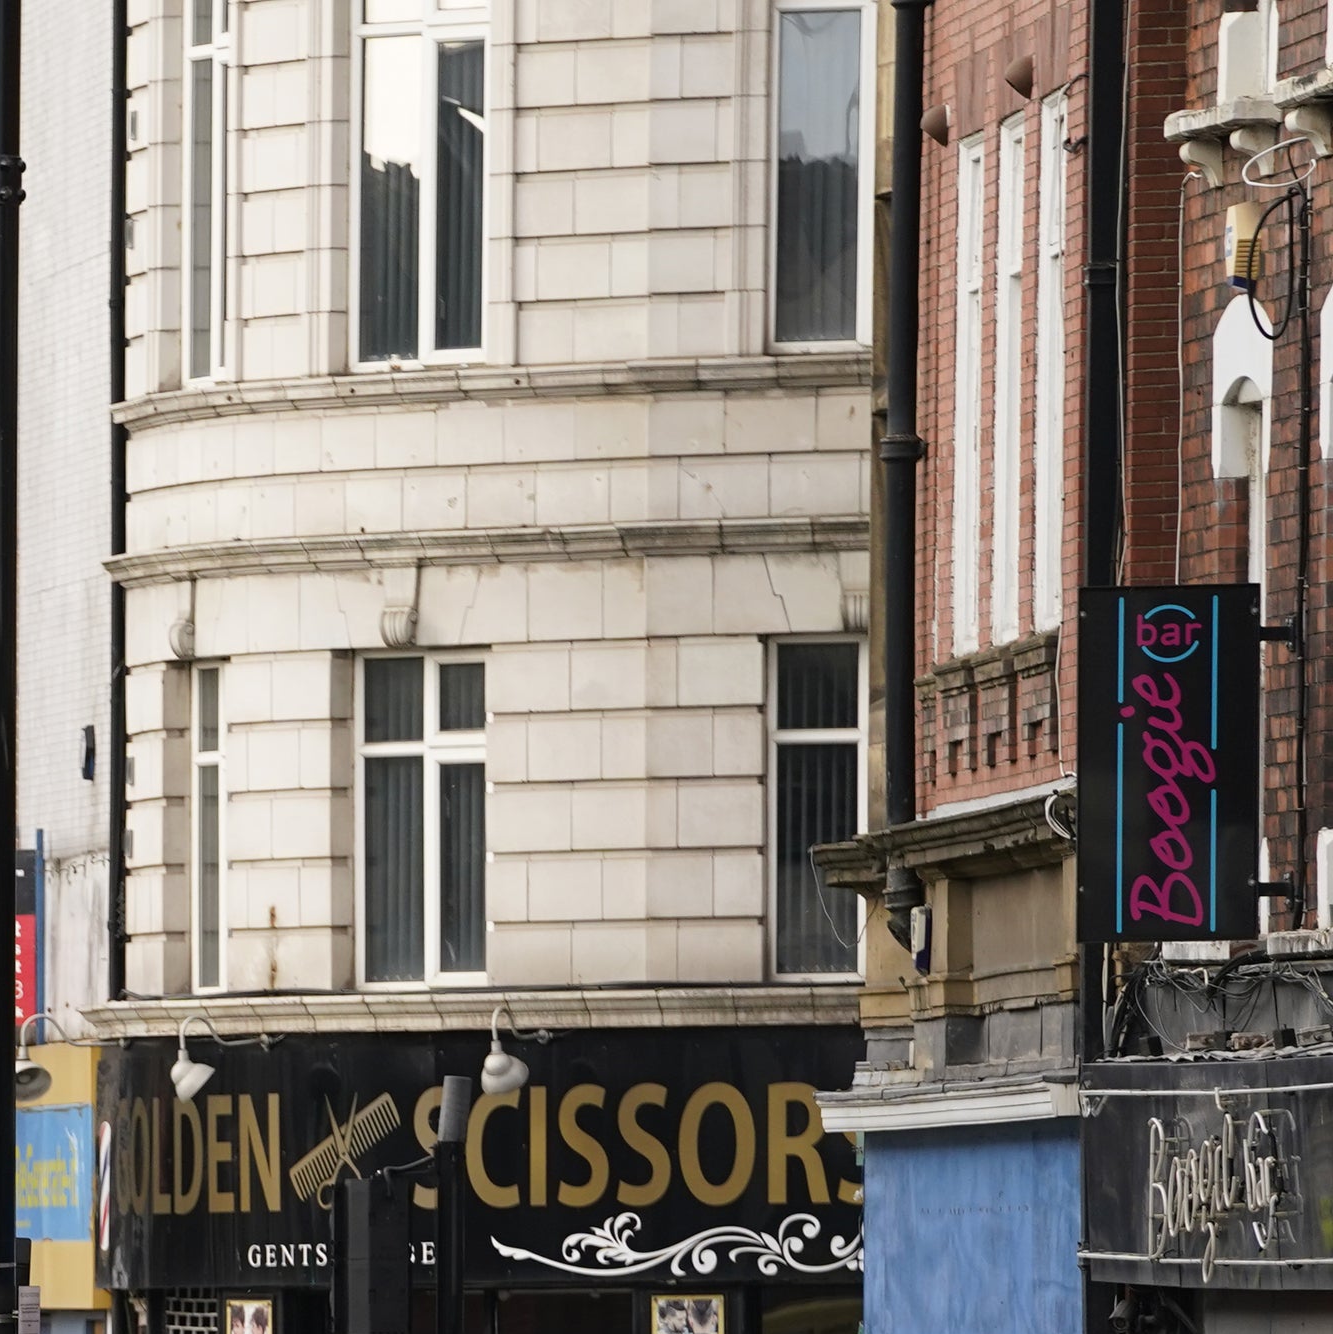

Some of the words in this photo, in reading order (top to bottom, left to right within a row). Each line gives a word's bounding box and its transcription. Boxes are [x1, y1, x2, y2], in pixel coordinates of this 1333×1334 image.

[1137, 614, 1202, 646] bar
[1120, 672, 1216, 926] Boogie
[116, 1092, 282, 1215] GOLDEN
[247, 1243, 328, 1268] GENTS
